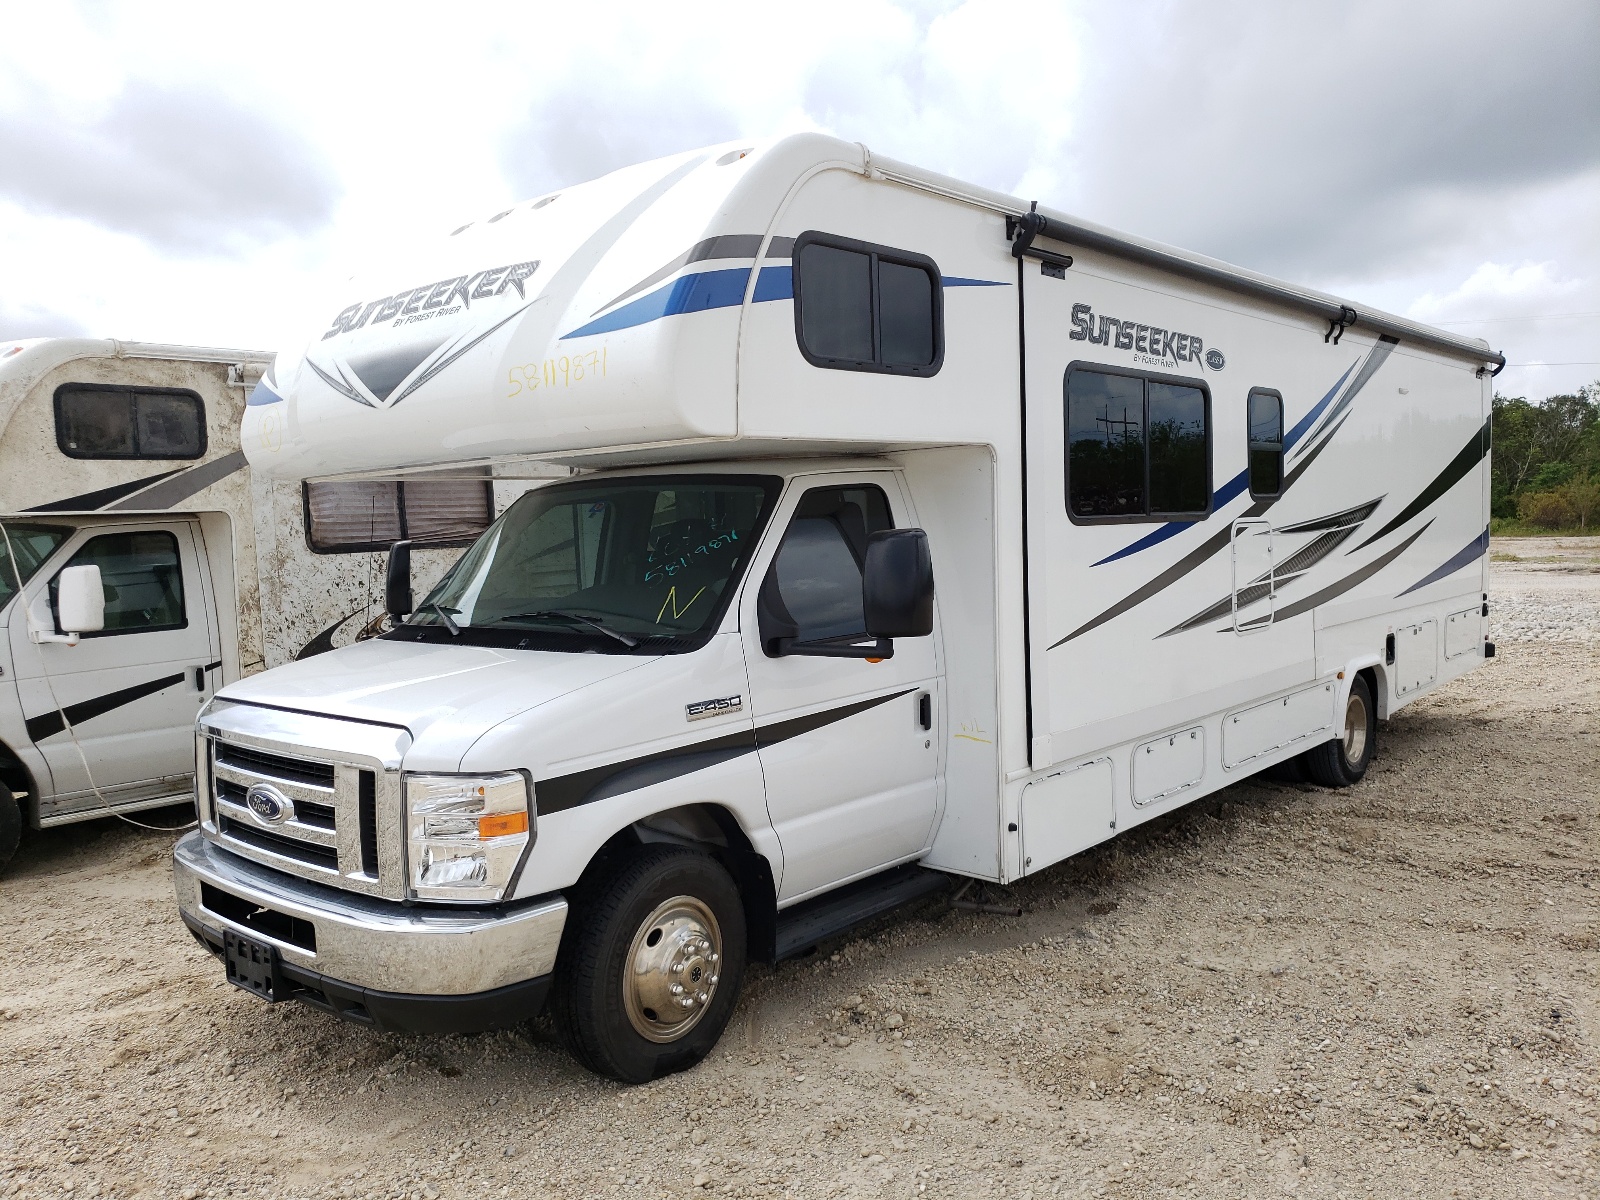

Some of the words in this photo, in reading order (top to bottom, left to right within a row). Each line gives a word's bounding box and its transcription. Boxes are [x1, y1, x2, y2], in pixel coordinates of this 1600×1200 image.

[392, 318, 405, 328] BY
[404, 310, 436, 326] FOREST
[435, 305, 462, 318] RIVER
[507, 346, 607, 398] 58119871
[655, 585, 707, 624] N
